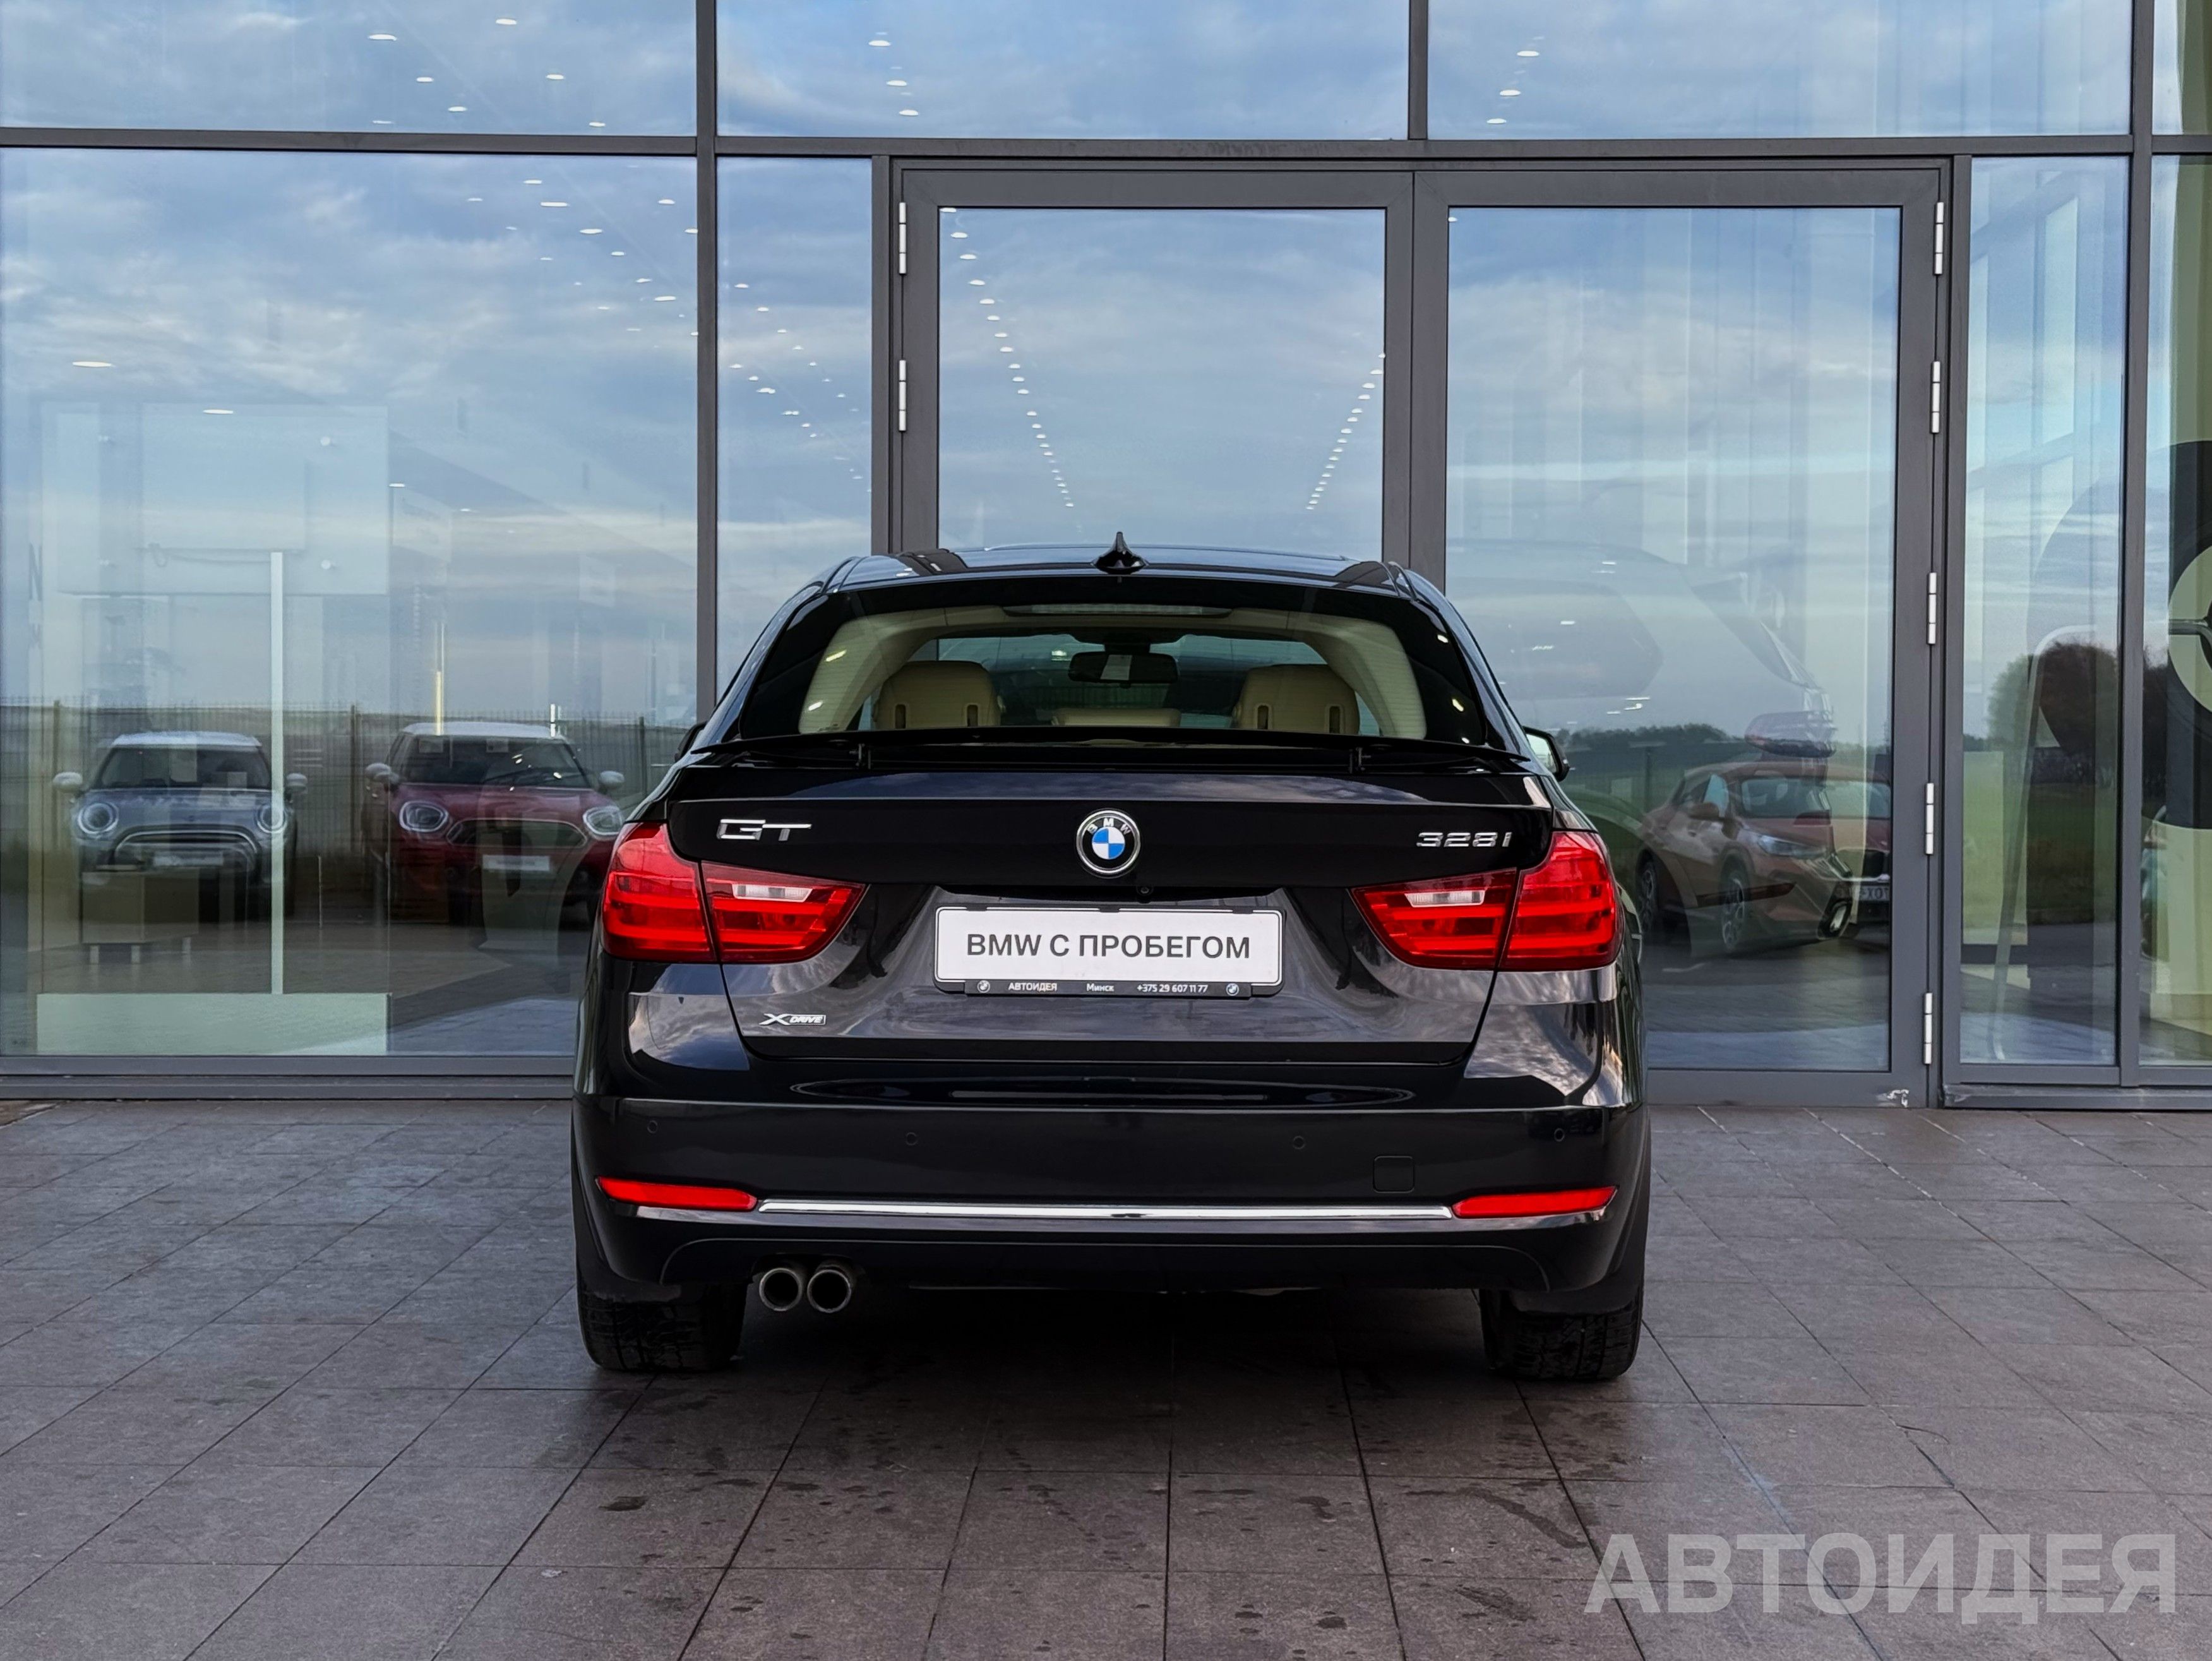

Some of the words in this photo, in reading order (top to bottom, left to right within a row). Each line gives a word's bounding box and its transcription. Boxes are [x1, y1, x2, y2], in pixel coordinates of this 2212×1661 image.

[716, 819, 812, 841] GT
[1087, 817, 1132, 835] BMW
[1416, 831, 1512, 848] 328i
[967, 933, 1041, 956] BMW
[1049, 934, 1070, 957] С
[1079, 935, 1250, 959] ПРОБЕГОМ
[1008, 982, 1058, 992] АВТОИДЕЯ
[1086, 983, 1115, 992] Минск
[1137, 983, 1157, 992] +375
[1158, 984, 1170, 992] 29
[1171, 984, 1187, 993] 607
[1189, 984, 1197, 992] 11
[1197, 985, 1209, 993] 77
